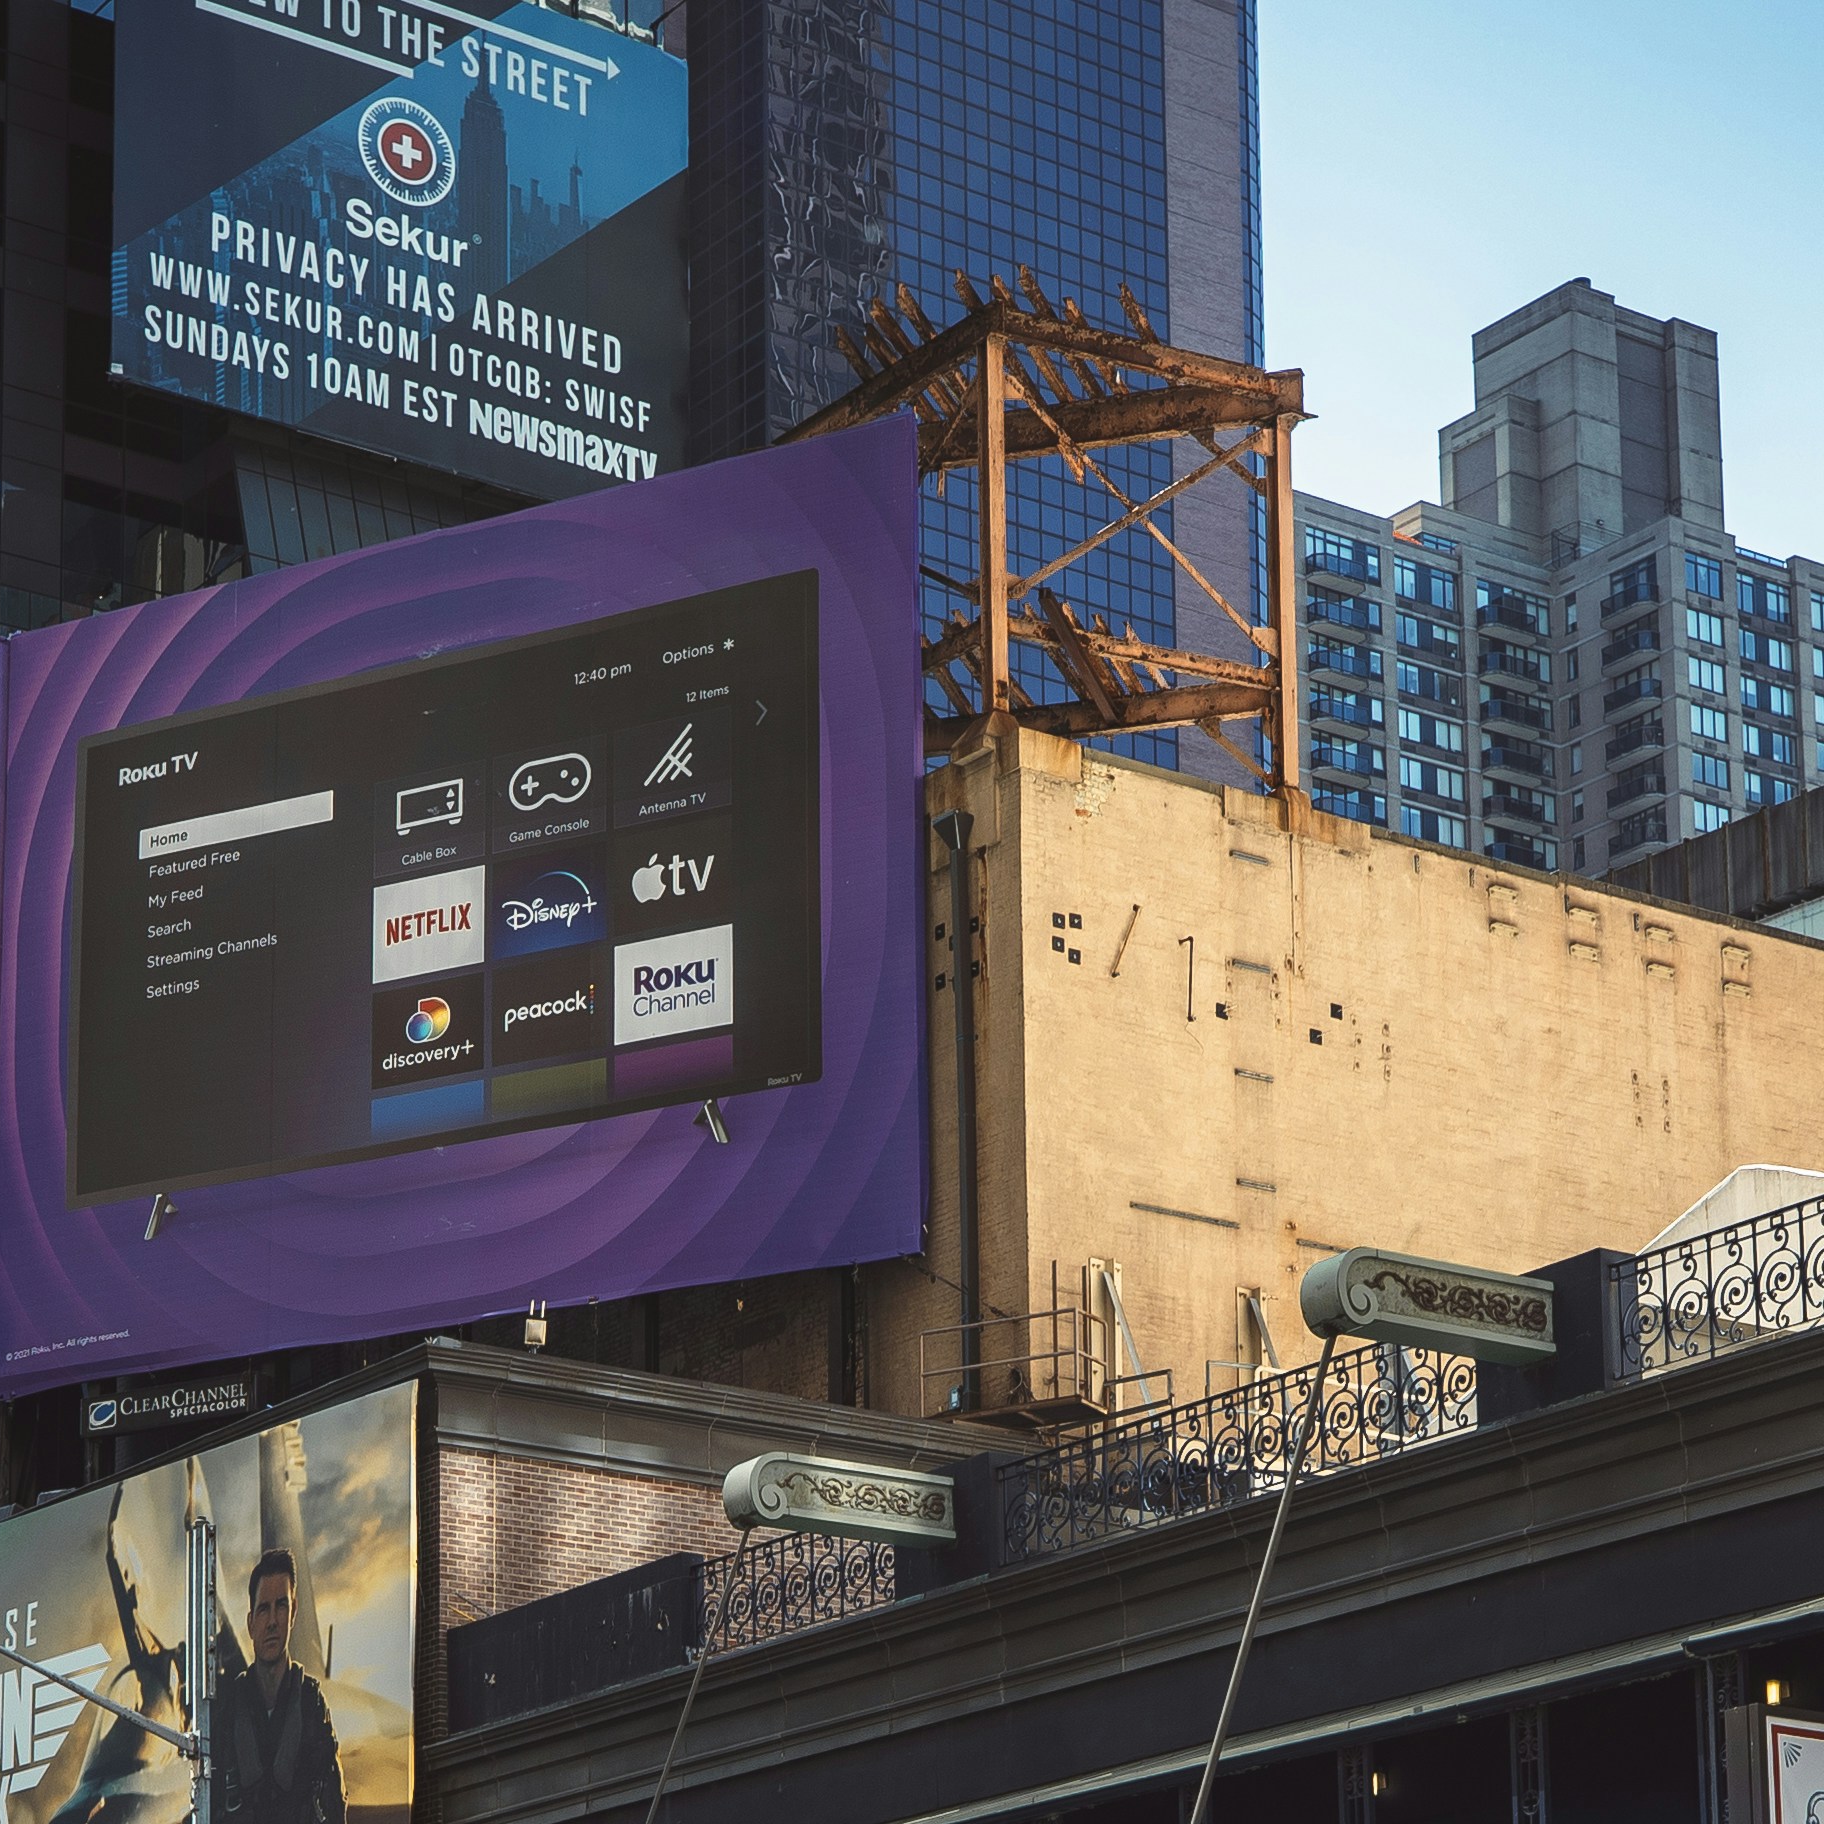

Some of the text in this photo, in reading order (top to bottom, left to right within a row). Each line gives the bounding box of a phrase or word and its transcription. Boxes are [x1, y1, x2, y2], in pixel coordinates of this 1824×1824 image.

[378, 6, 592, 116] THE STREET
[346, 198, 468, 267] Sekur
[211, 213, 621, 374] PRIVACY HAS ARRIVED
[150, 252, 651, 432] WWW.SEKUR.COM OTCQB: SWISF
[145, 305, 456, 426] SUNDAYS 10AM EST
[662, 643, 714, 664] Options
[574, 662, 631, 685] 12:40 pm
[686, 685, 729, 703] 12 Items
[172, 752, 198, 773] TV
[639, 793, 706, 816] Antenna TV
[150, 830, 188, 848] Home
[509, 818, 589, 843] Game Console
[149, 850, 240, 878] Featured Free
[402, 845, 457, 866] Cable Box
[148, 886, 204, 909] My Feed
[147, 920, 191, 938] Search
[386, 903, 471, 947] NETFLIX
[147, 932, 277, 968] Streaming Channels
[146, 978, 200, 998] Settings
[505, 991, 587, 1032] peacock
[633, 986, 715, 1018] Channel
[382, 1040, 474, 1070] discovery+
[66, 1338, 76, 1347] All
[170, 1399, 246, 1418] SPECTACOLOR
